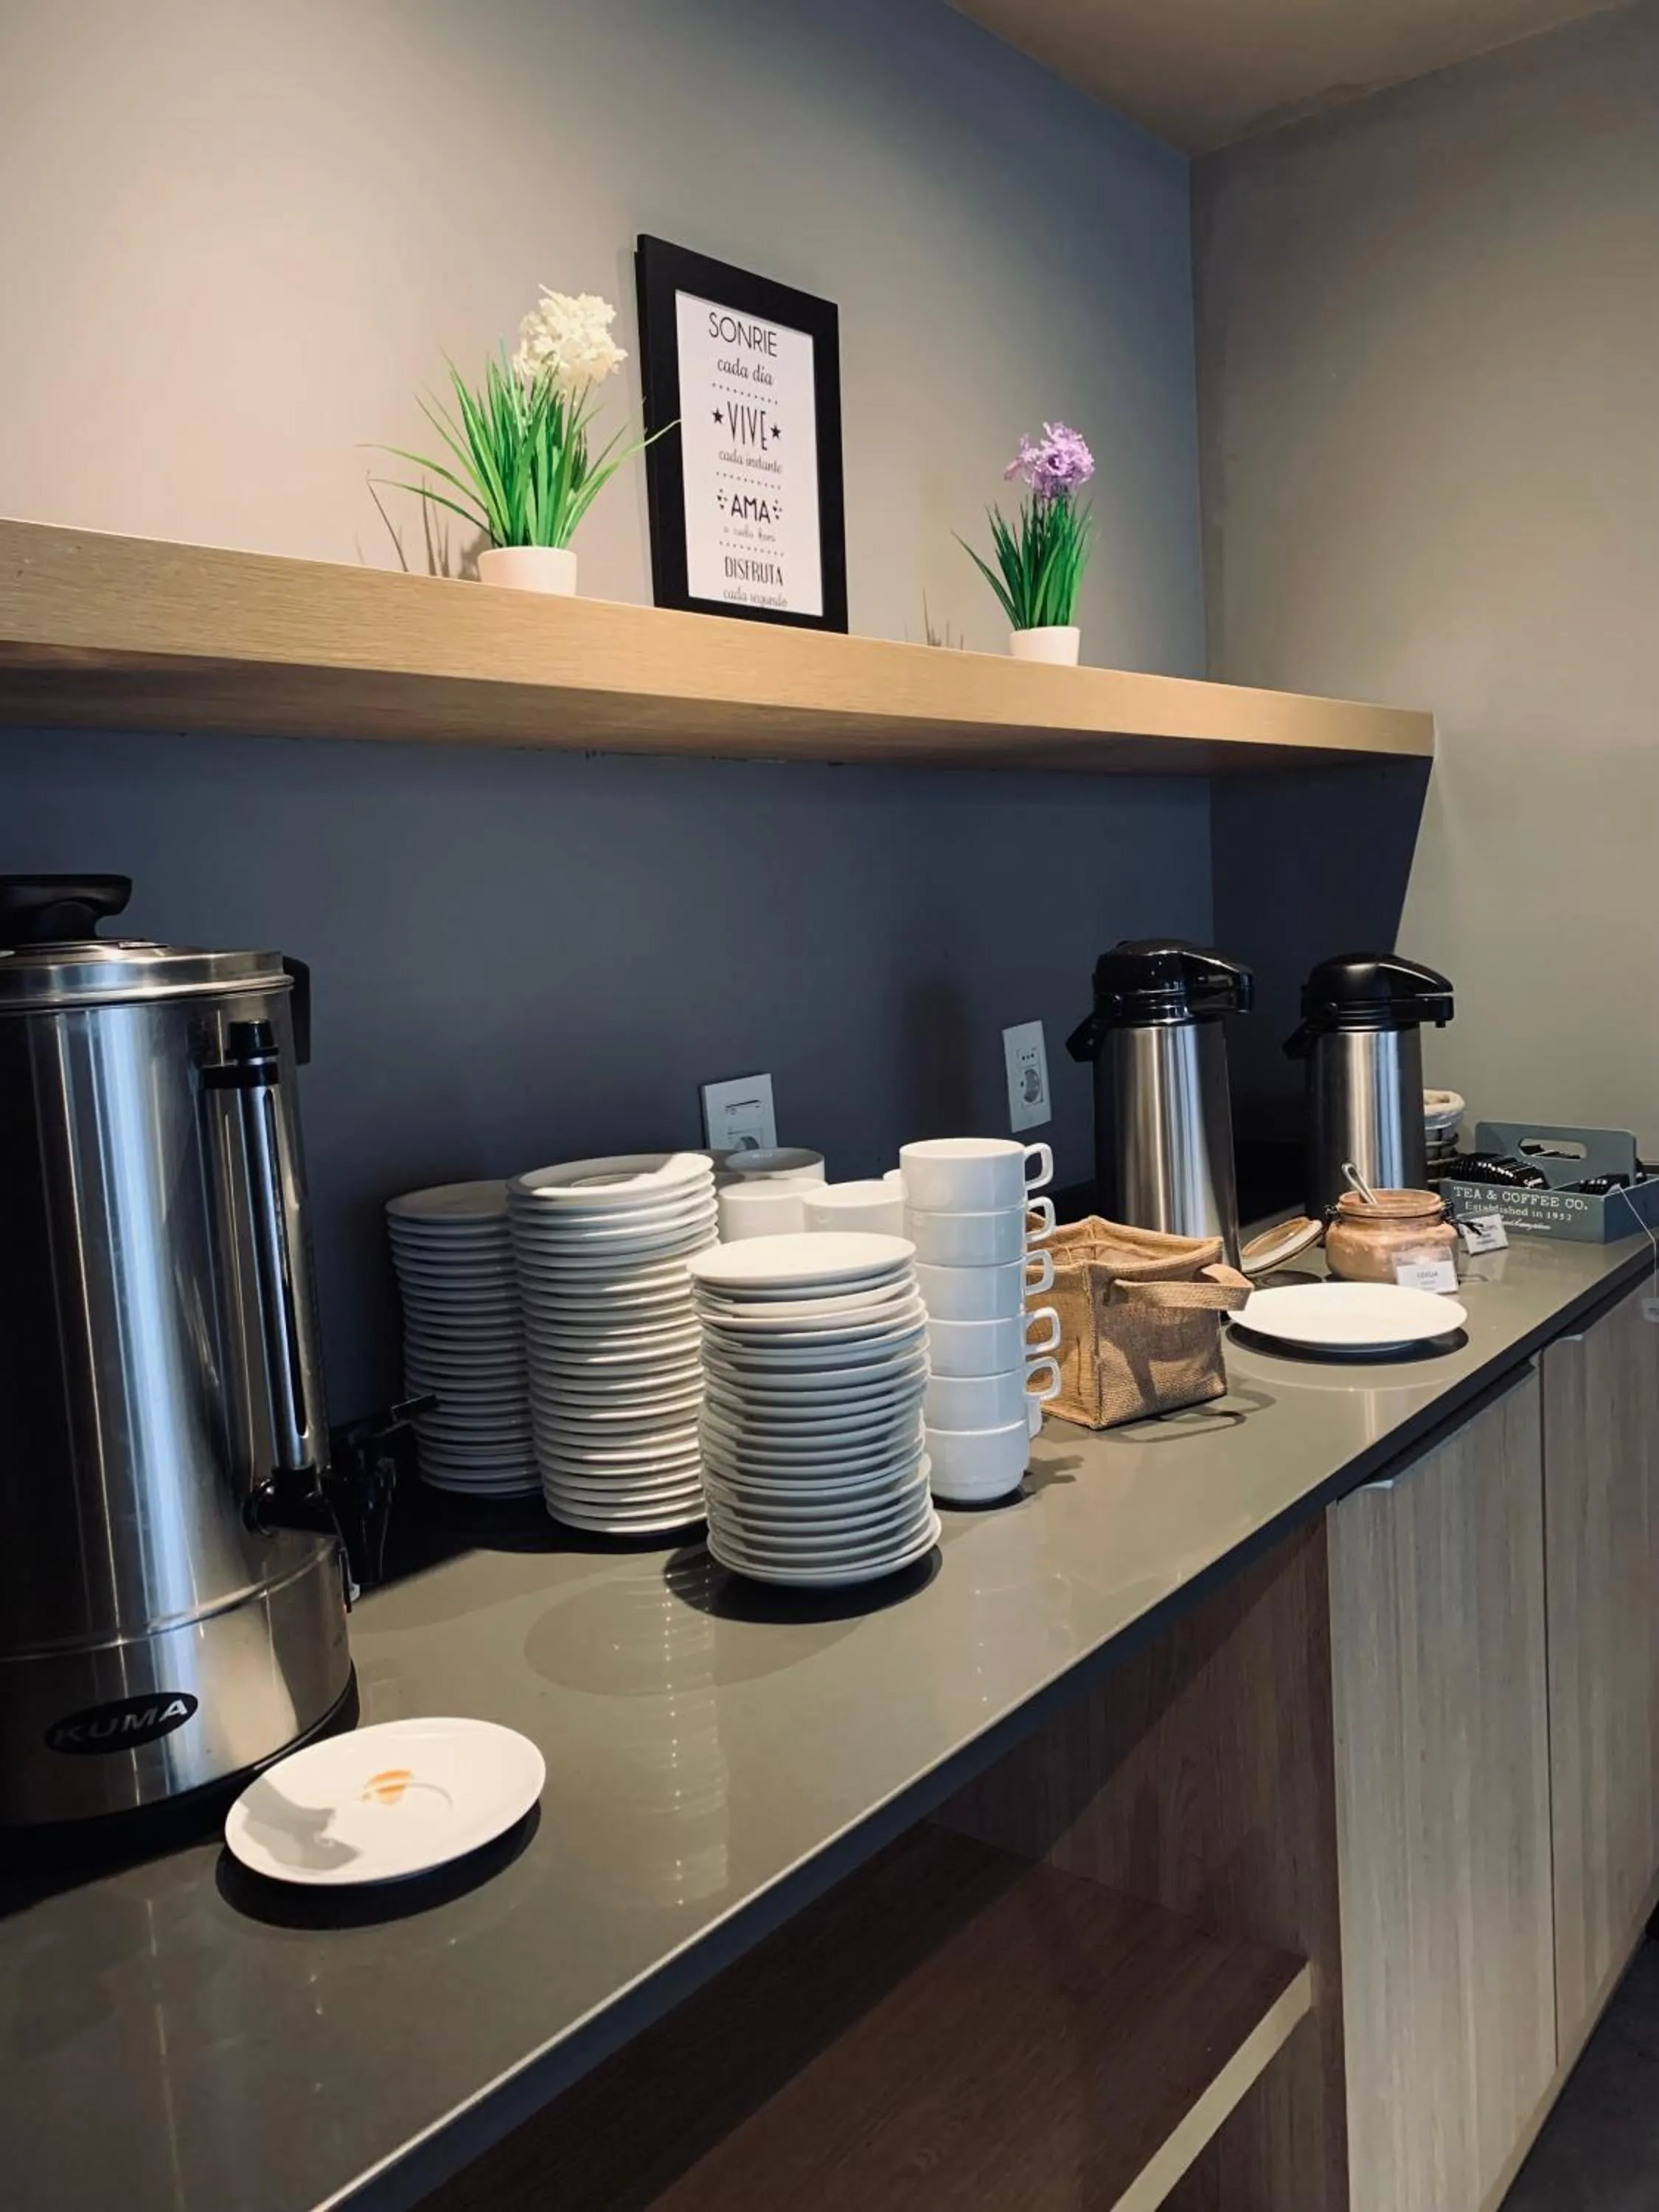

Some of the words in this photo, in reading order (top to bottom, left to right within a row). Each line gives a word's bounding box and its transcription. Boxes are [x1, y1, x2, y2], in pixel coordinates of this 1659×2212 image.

[709, 312, 778, 358] SONRIE
[717, 358, 748, 379] cada
[727, 400, 768, 451] VIVE
[718, 448, 743, 465] cada
[745, 453, 783, 474] instante
[731, 493, 771, 524] AMA
[725, 556, 784, 587] DISFRUTA
[723, 586, 748, 602] cada
[1453, 1186, 1482, 1200] TEA
[1486, 1190, 1498, 1200] &
[1502, 1191, 1560, 1208] COFFEE
[1565, 1198, 1589, 1211] CO.
[1531, 1210, 1543, 1218] in
[52, 1699, 189, 1745] KUMA
